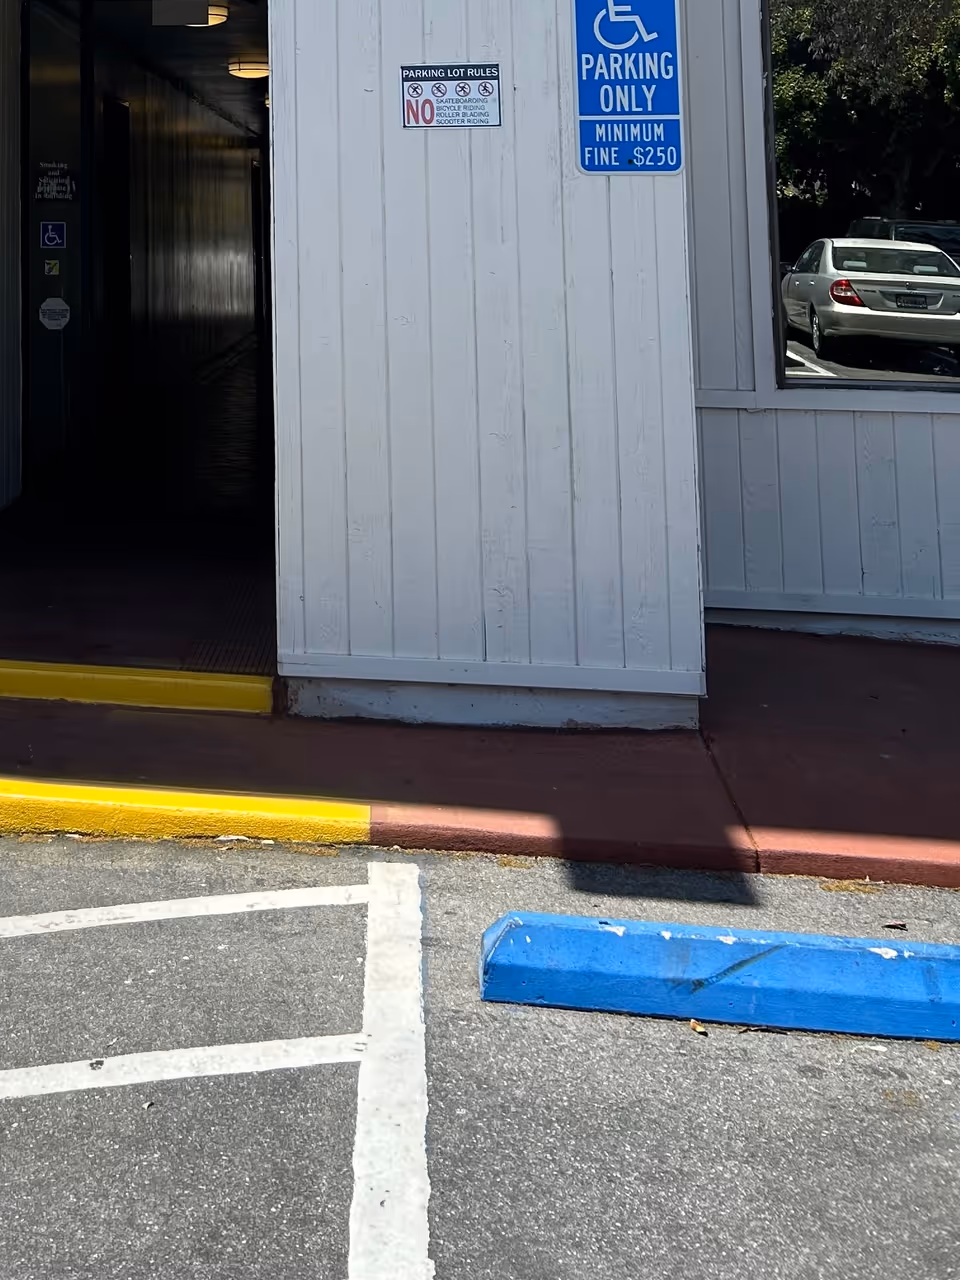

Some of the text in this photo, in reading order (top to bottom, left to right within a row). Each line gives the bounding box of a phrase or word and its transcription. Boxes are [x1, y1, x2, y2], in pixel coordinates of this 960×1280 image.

[403, 68, 498, 78] PARKING LOT RULES
[581, 51, 674, 80] PARKING
[600, 84, 657, 112] ONLY
[406, 99, 435, 125] NO
[596, 123, 665, 142] MINIMUM
[585, 146, 677, 167] FINE $250
